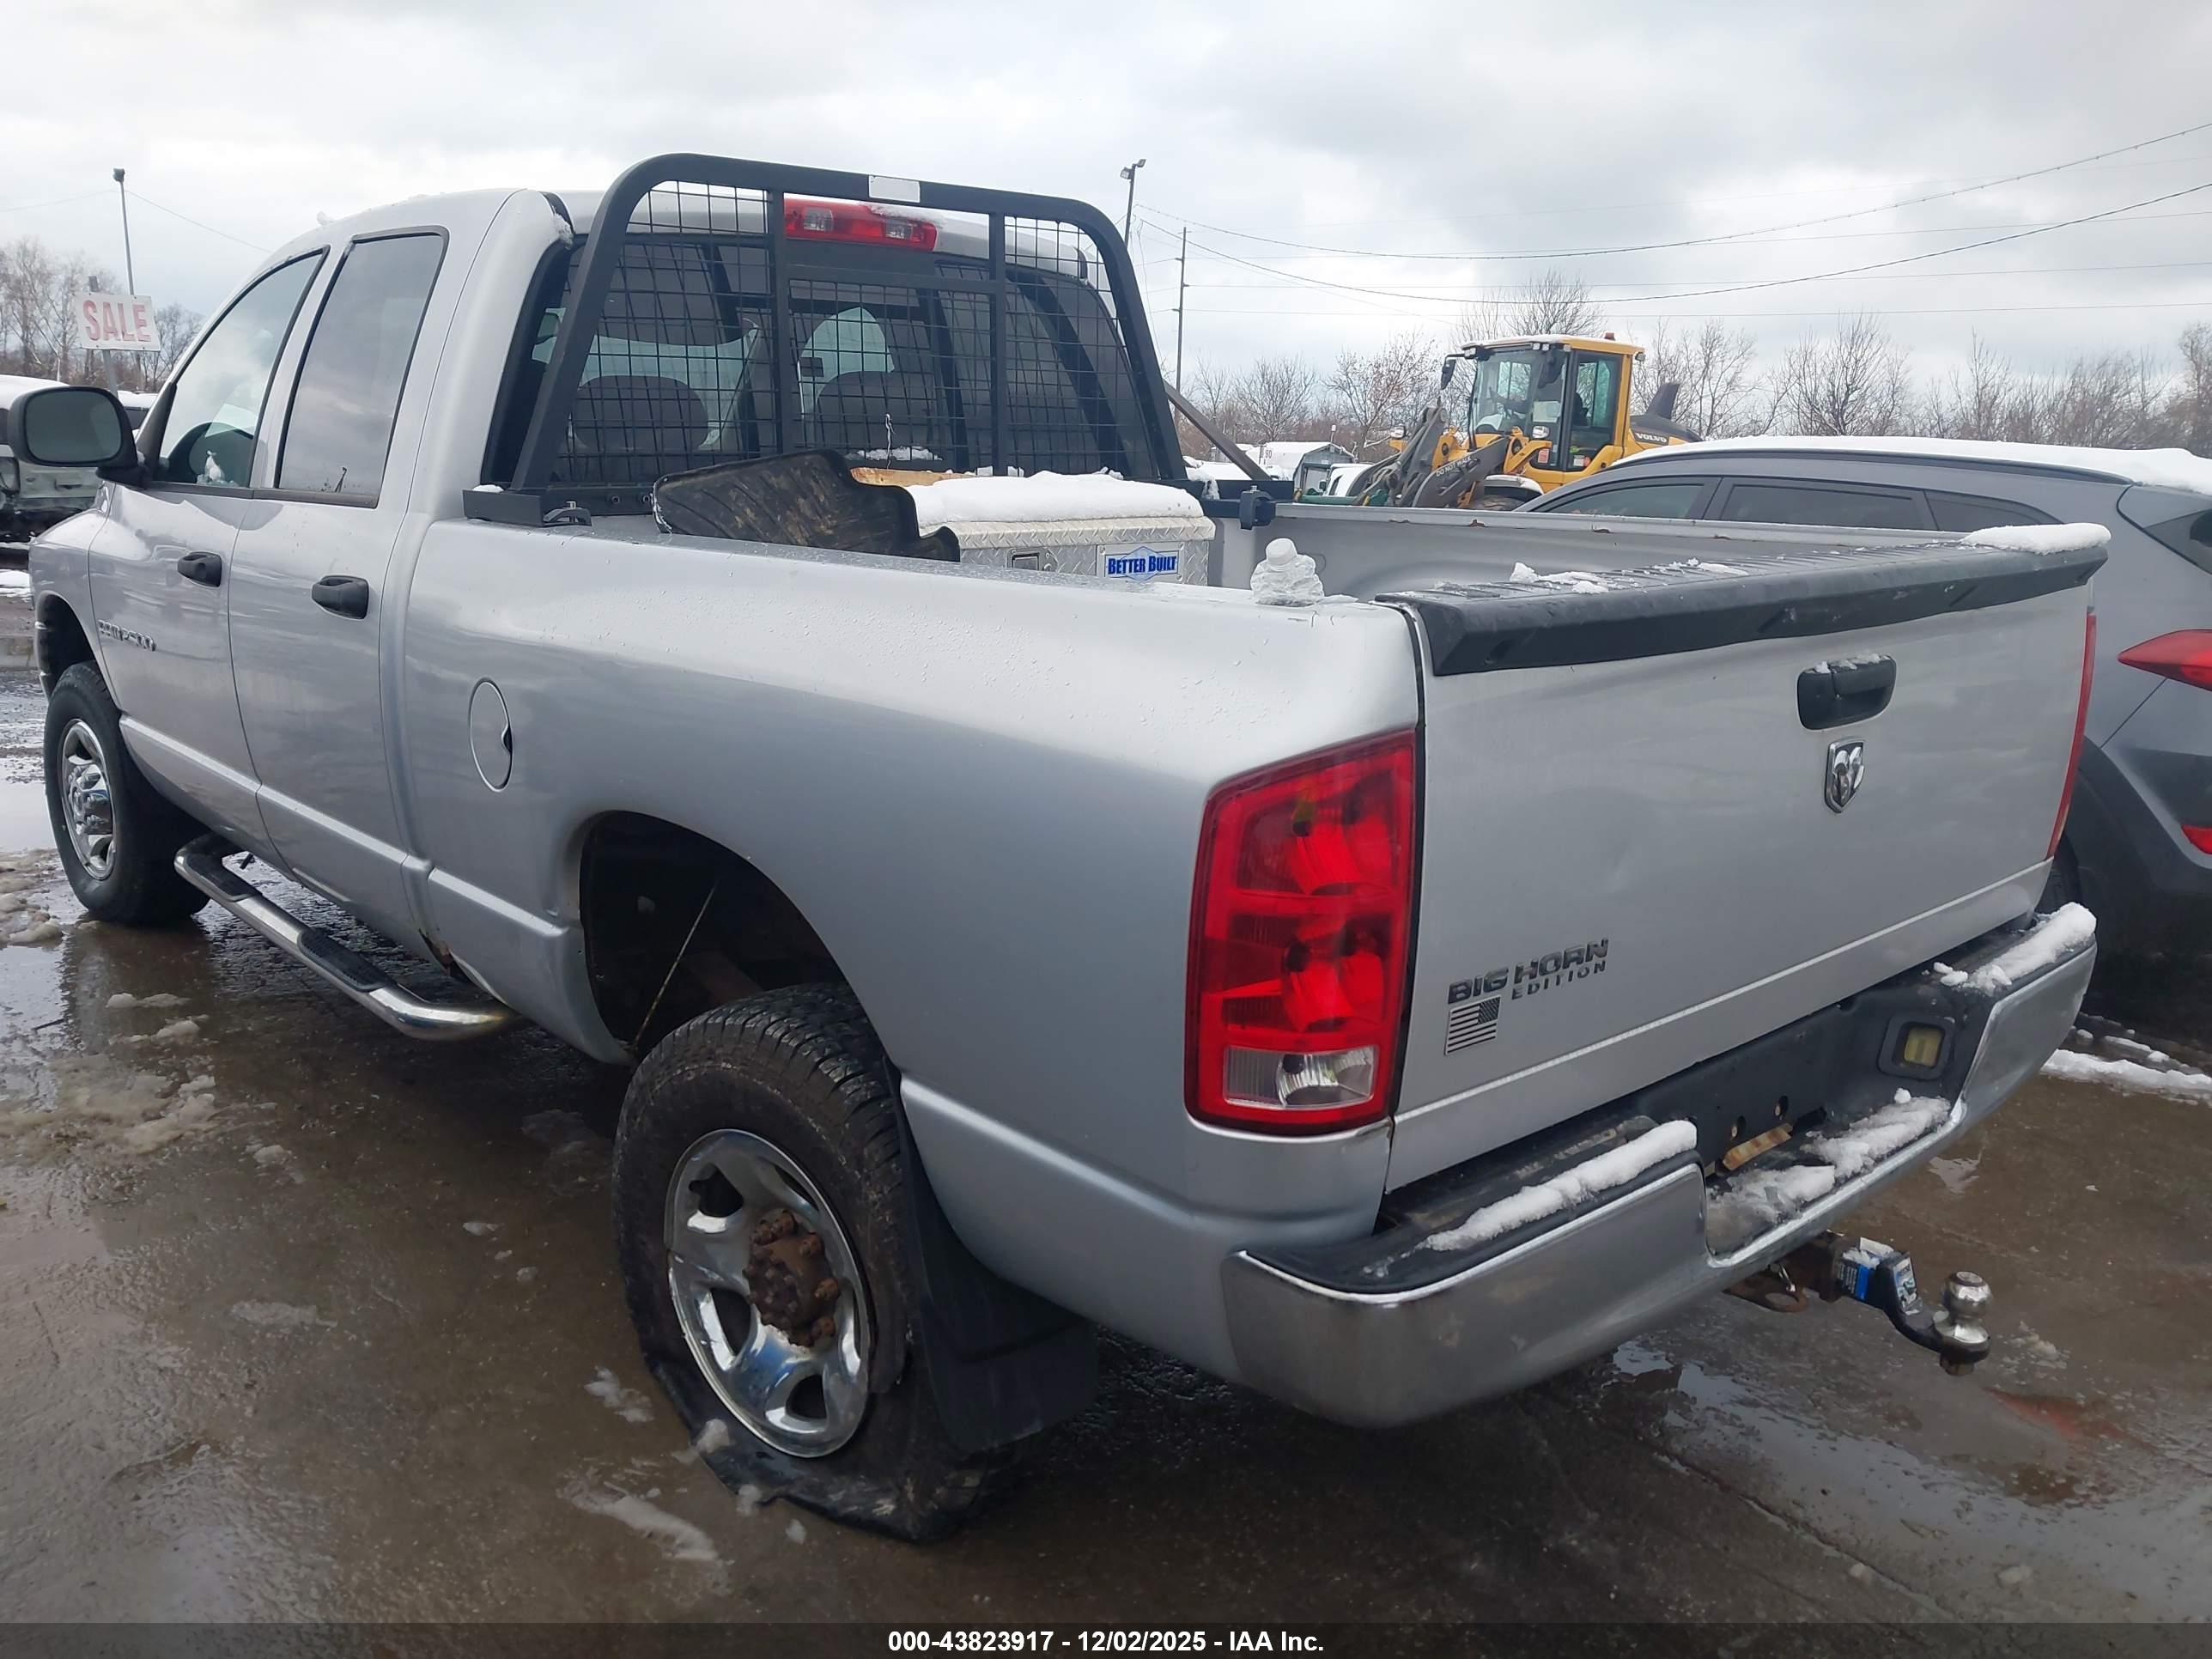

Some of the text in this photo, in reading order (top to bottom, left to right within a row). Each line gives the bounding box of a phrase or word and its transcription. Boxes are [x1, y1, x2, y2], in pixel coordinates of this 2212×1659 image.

[82, 300, 152, 343] SALE
[1634, 432, 1668, 443] VOLVO
[1436, 468, 1445, 477] DO
[1444, 462, 1457, 473] NOT
[1107, 555, 1177, 575] BETTER BUILT
[1447, 938, 1609, 1005] BIG HORN
[1510, 959, 1607, 1000] EDITION
